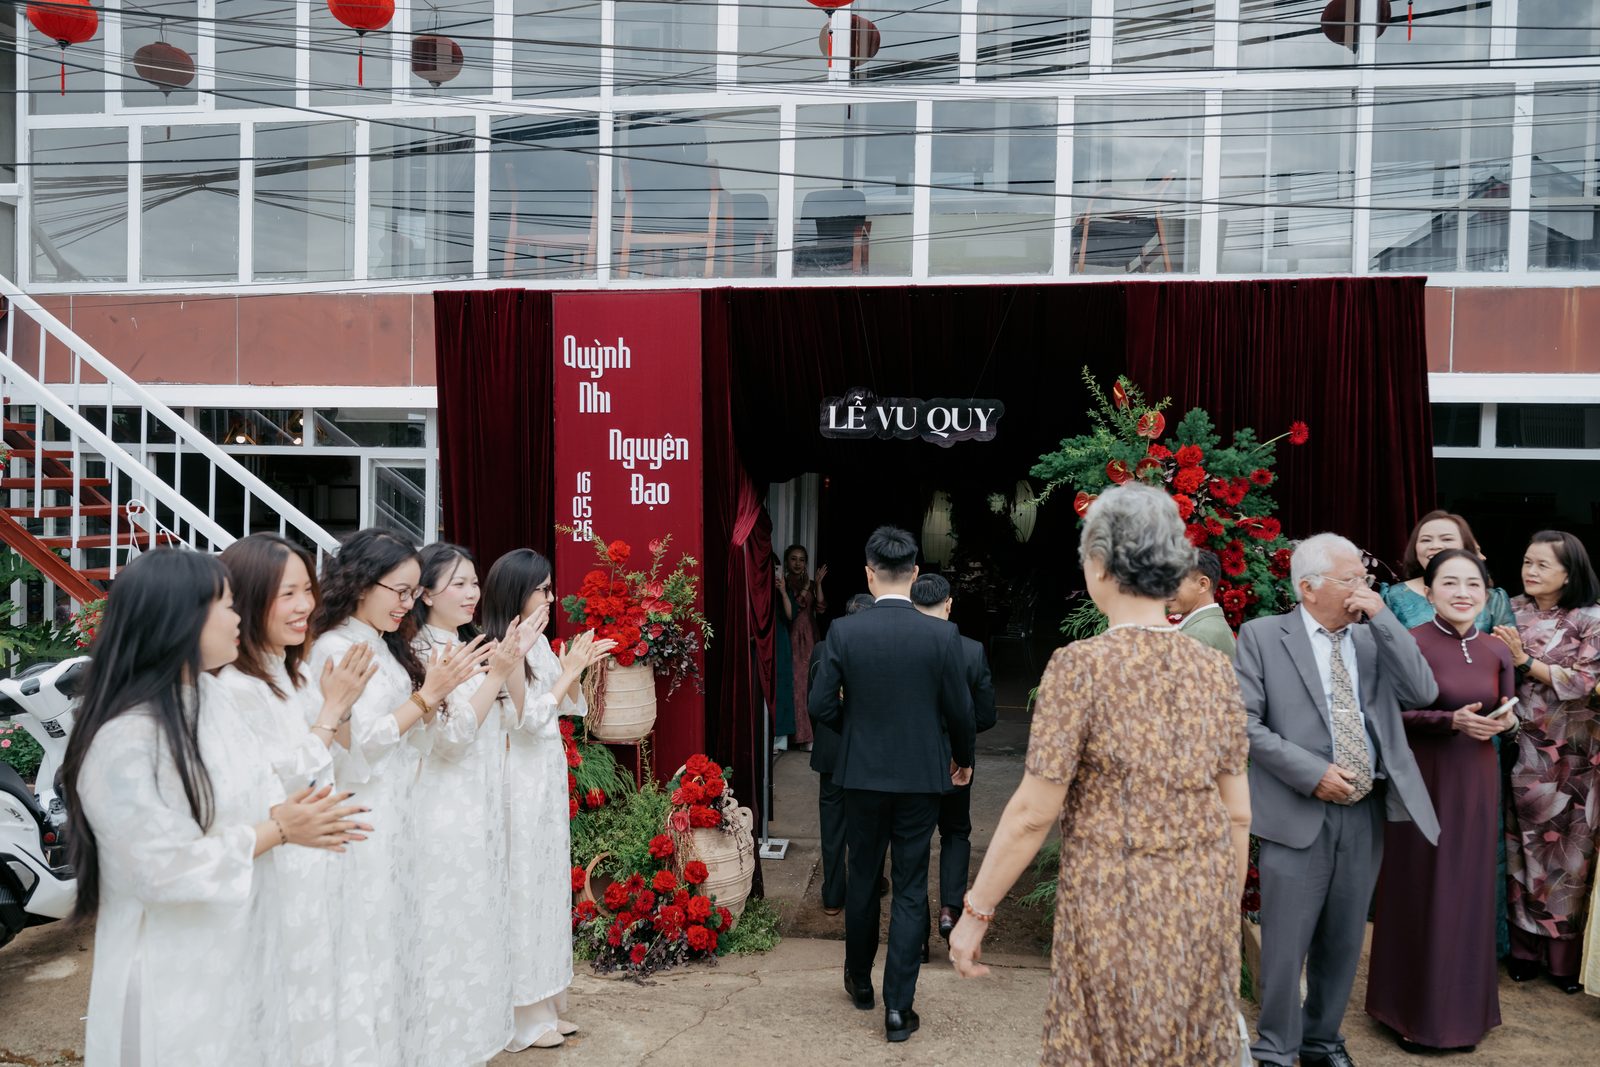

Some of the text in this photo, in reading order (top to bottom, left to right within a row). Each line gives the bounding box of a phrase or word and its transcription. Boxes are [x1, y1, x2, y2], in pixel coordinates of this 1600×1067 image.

[563, 335, 631, 378] Quỳnh
[579, 382, 611, 413] Nhi
[828, 395, 995, 438] LỄ VU QUY
[609, 429, 689, 470] Nguyên
[576, 471, 591, 494] 16
[630, 473, 670, 511] Đạo
[572, 496, 592, 518] 05
[573, 519, 593, 542] 26
